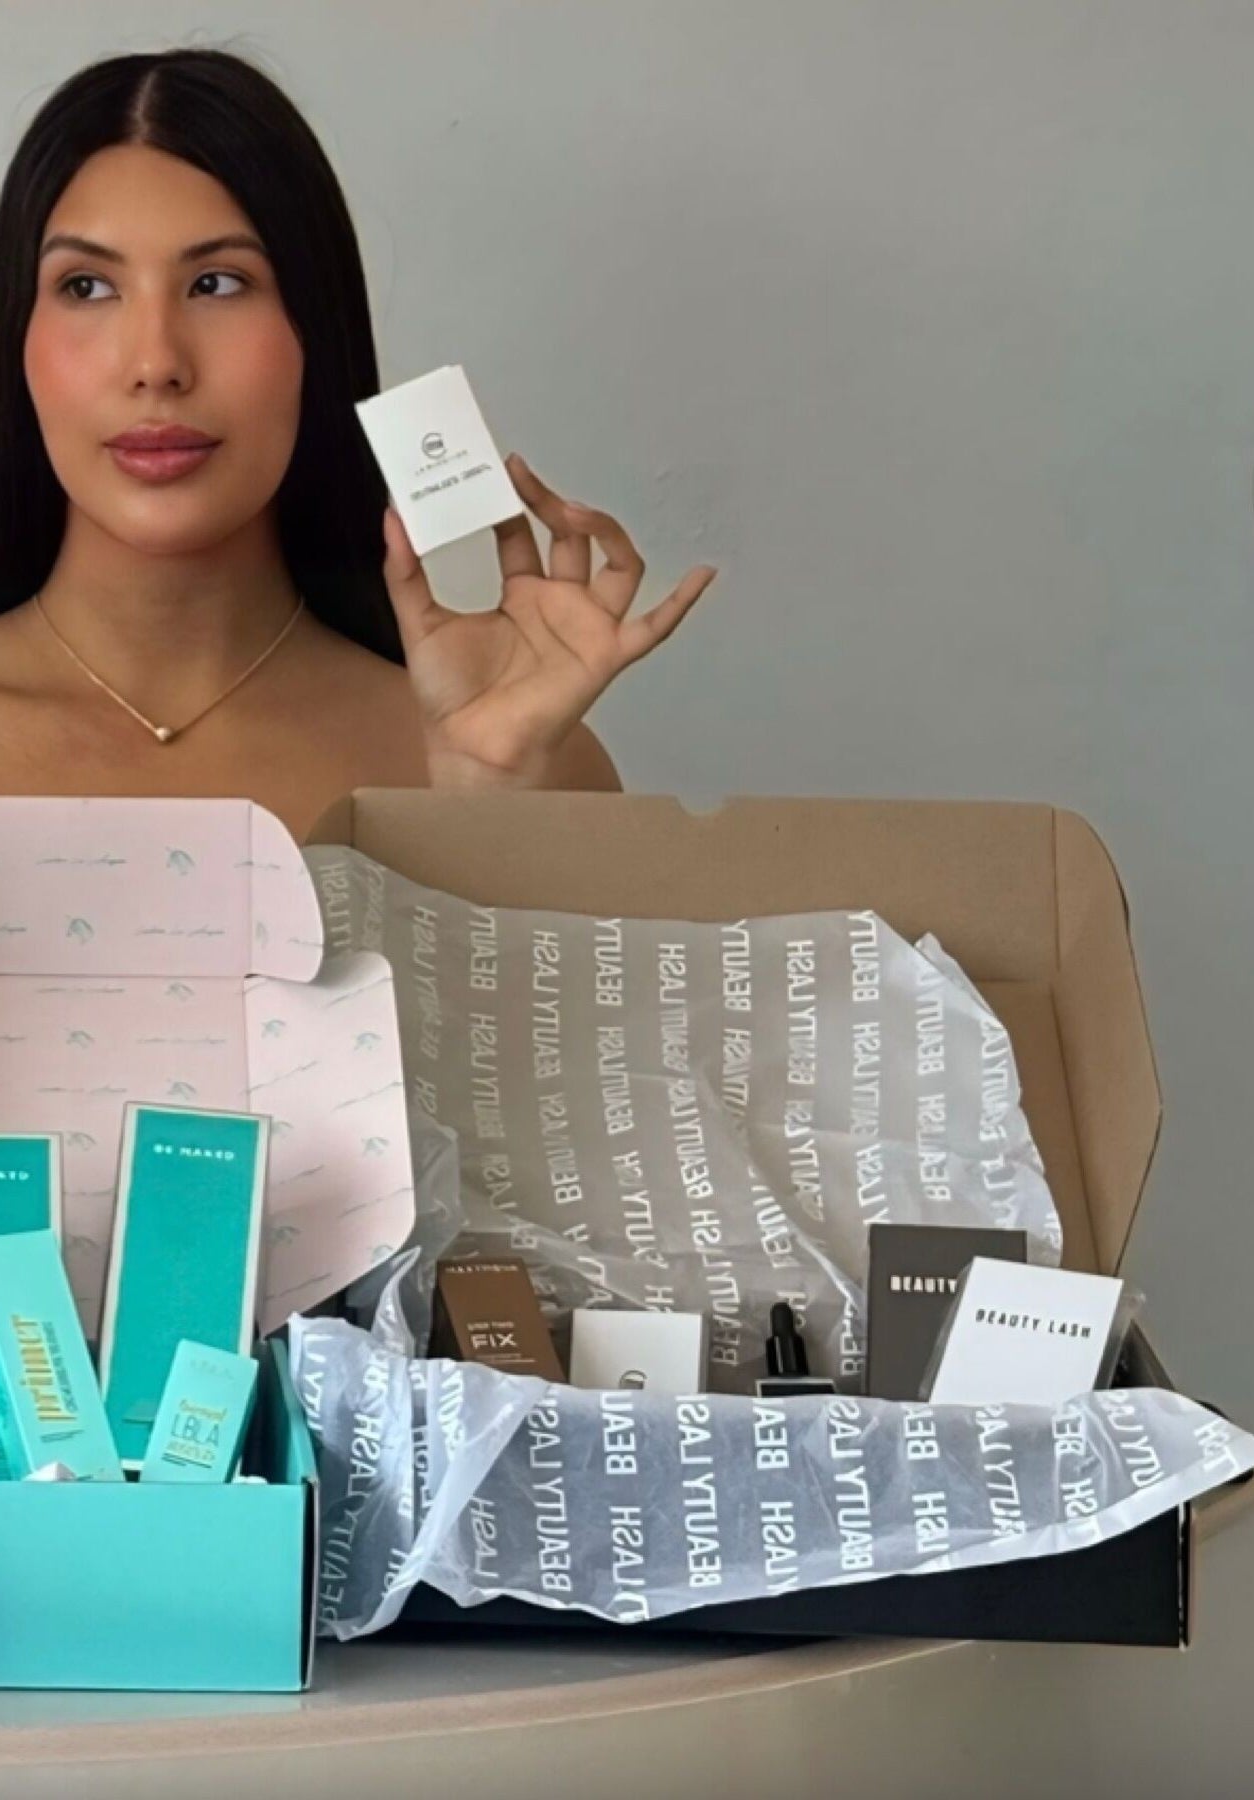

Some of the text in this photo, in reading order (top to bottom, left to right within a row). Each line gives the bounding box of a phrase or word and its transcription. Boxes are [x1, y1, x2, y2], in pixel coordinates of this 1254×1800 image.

[889, 1274, 958, 1293] BEAUTY
[975, 1307, 1092, 1338] BEAUTY LASH
[471, 1332, 518, 1350] FIX
